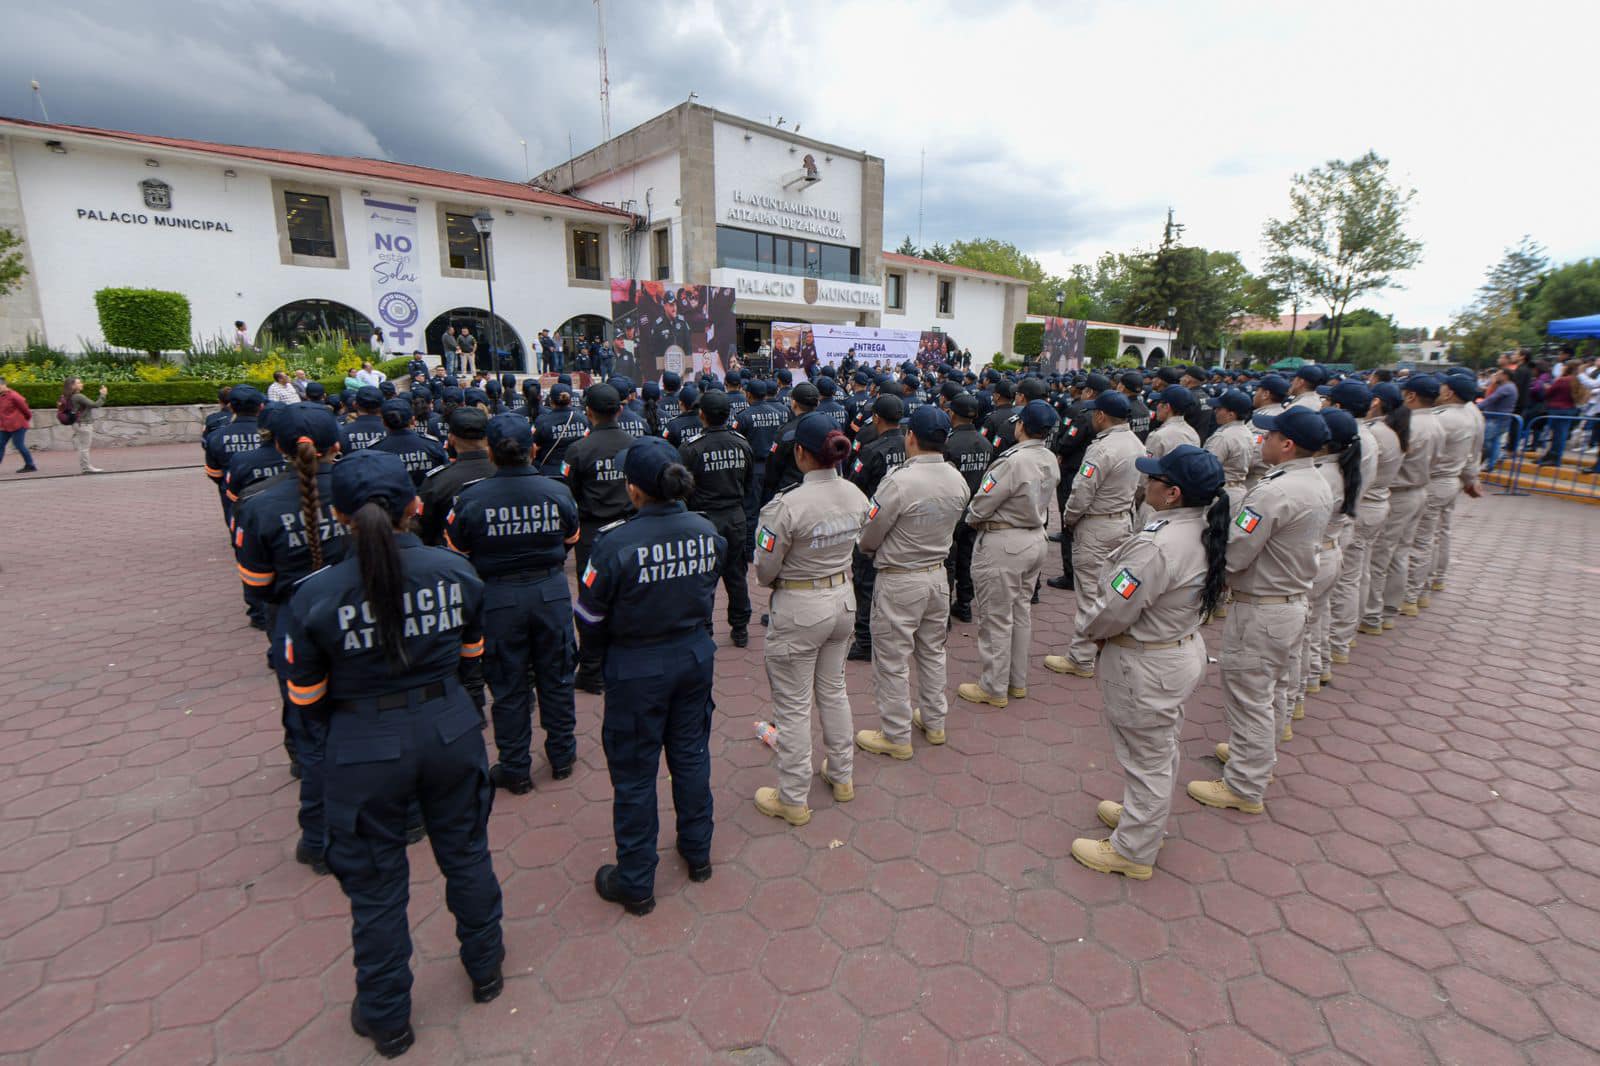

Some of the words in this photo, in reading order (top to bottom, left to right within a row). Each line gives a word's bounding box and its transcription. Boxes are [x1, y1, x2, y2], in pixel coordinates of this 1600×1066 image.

[749, 194, 829, 219] AYUNTAMIENTO
[76, 208, 148, 224] PALACIO
[153, 215, 233, 232] MUNICIPAL
[797, 219, 848, 240] ZARAGOZA
[374, 232, 413, 253] NO
[373, 261, 417, 285] Solas
[736, 276, 796, 297] PALACIO
[818, 286, 882, 306] MUNICIPAL
[853, 342, 886, 352] ENTREGA
[400, 451, 428, 463] LICÍA
[702, 447, 745, 462] POLICÍA
[484, 501, 560, 523] POLICÍA
[637, 534, 715, 566] POLICÍA
[338, 580, 463, 630] POICÍA
